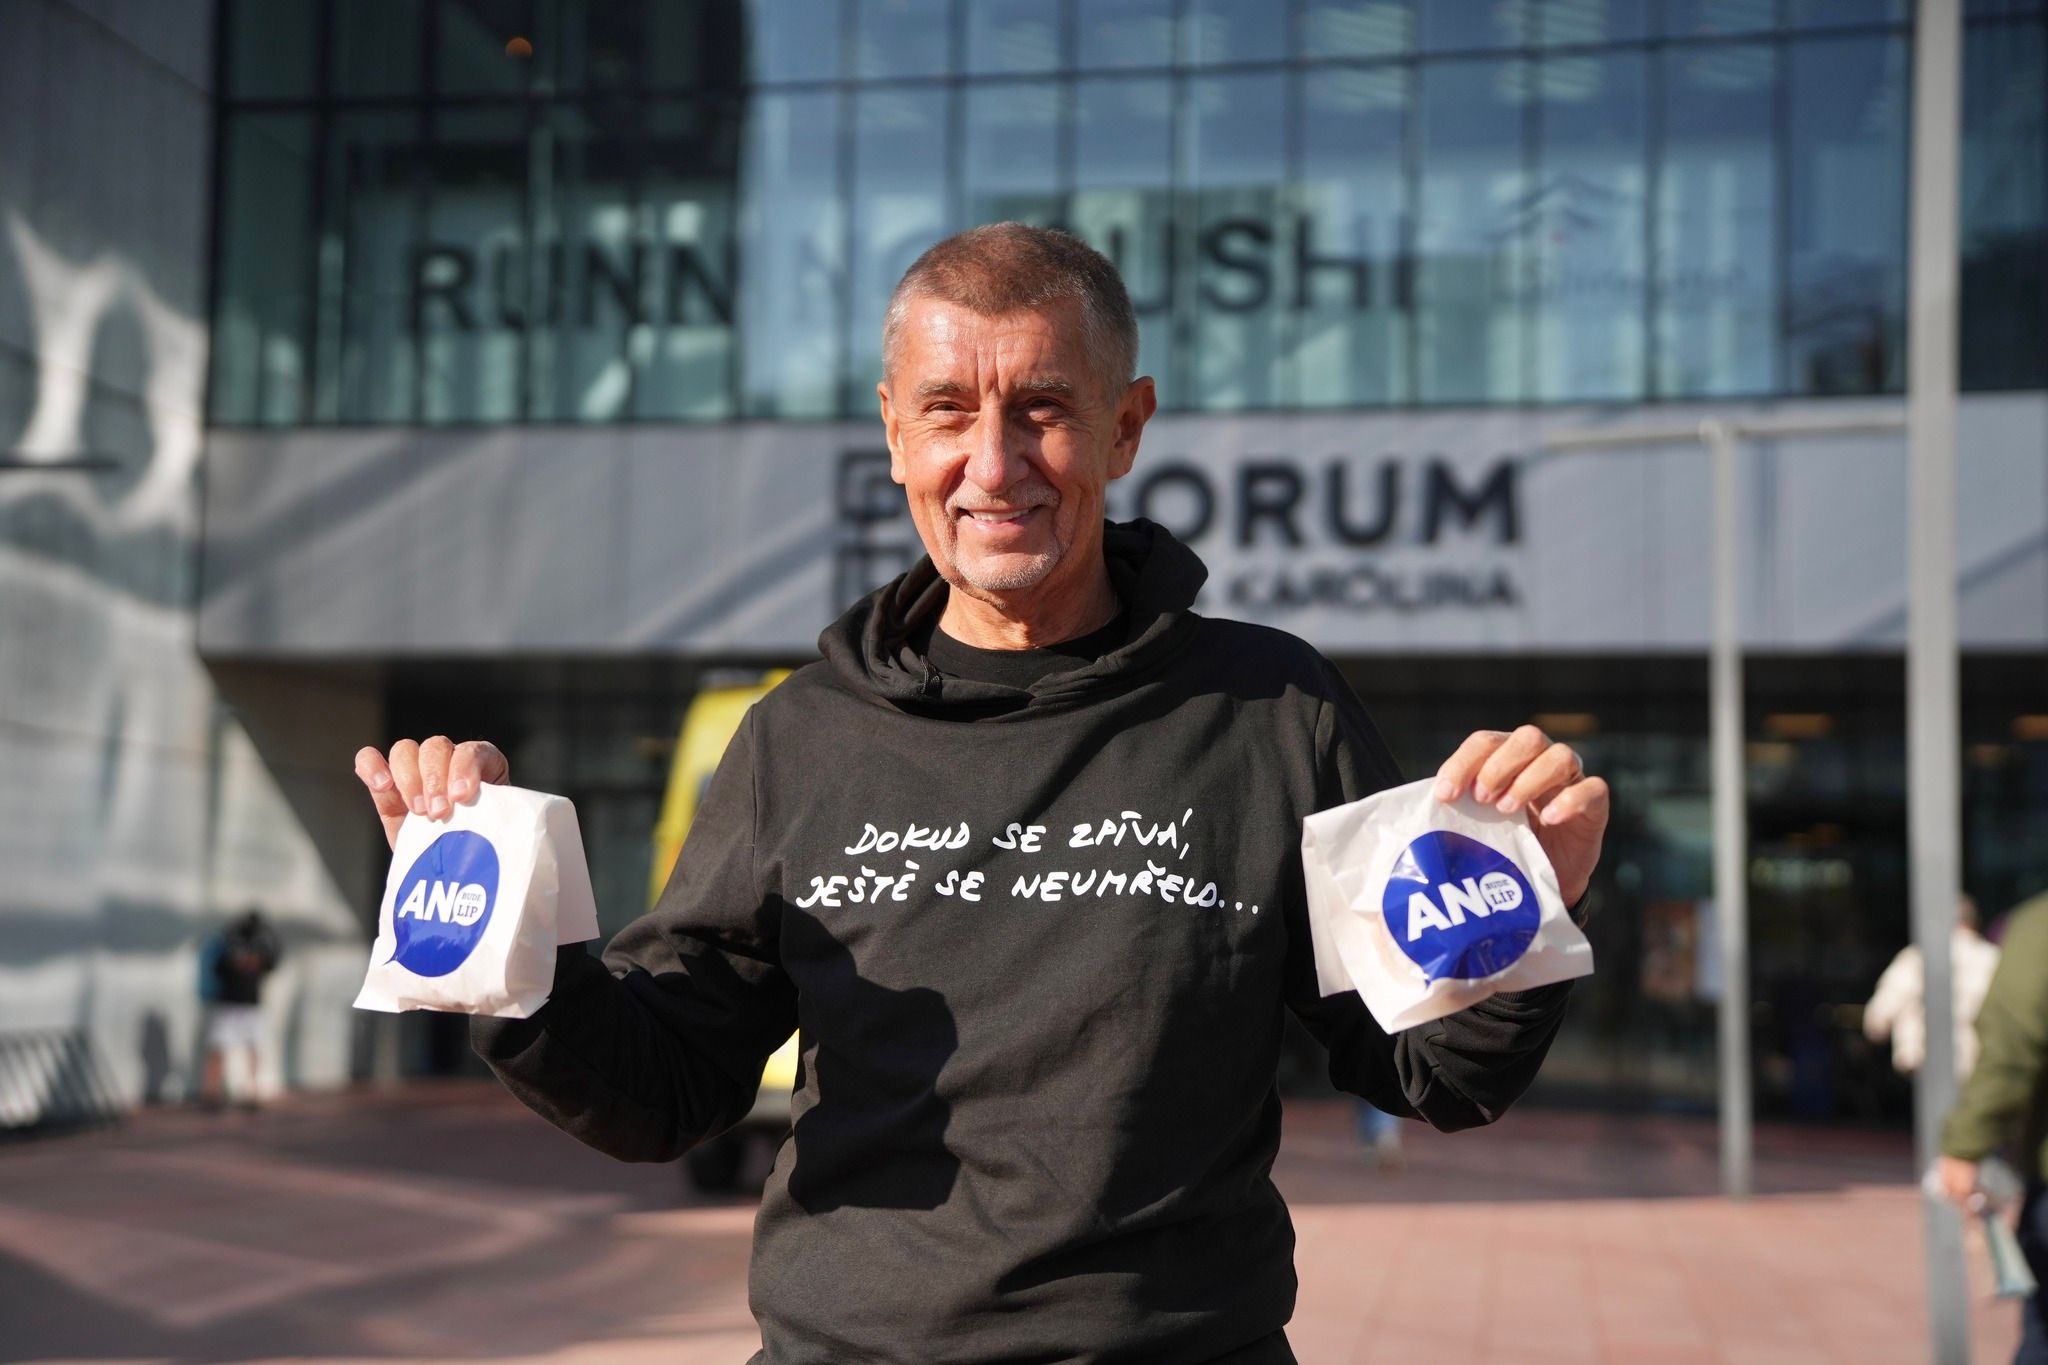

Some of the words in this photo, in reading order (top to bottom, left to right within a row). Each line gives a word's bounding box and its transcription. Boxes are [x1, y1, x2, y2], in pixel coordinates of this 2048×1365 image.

[1050, 217, 1415, 315] USHI
[1104, 455, 1522, 548] ORUM
[844, 821, 971, 856] DOKUD
[992, 822, 1047, 853] SE
[461, 892, 481, 901] BUDE
[795, 859, 920, 909] JEŠTĚ
[934, 869, 985, 902] SE
